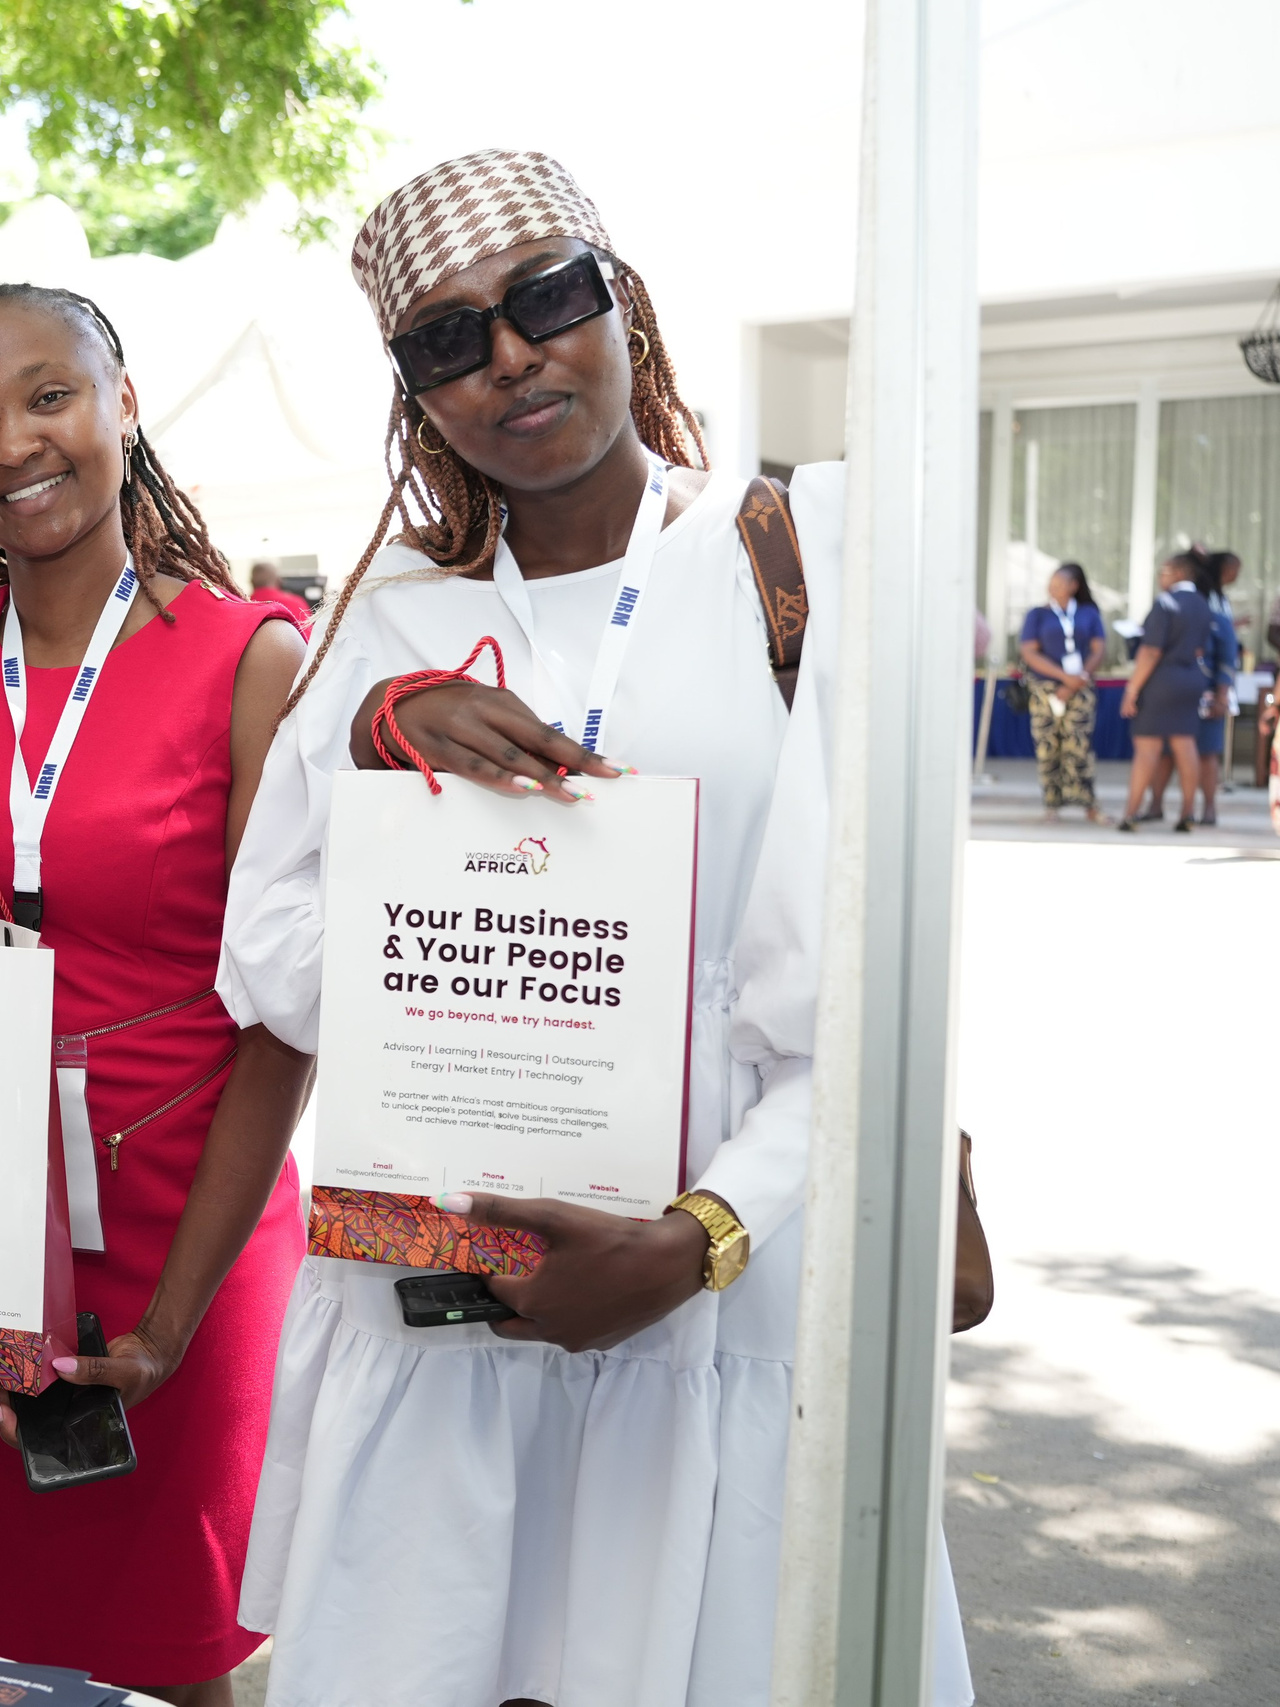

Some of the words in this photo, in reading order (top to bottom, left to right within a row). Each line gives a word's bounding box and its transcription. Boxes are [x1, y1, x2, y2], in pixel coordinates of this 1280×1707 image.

[114, 567, 136, 602] IHRM
[610, 586, 640, 627] IHRM
[3, 657, 20, 688] IHRM
[72, 666, 97, 701] IHRM
[580, 709, 603, 753] IHRM
[34, 763, 57, 799] IHRM
[463, 859, 529, 875] AFRICA
[464, 851, 528, 863] WORKFORCE
[383, 902, 463, 931] Your
[473, 907, 629, 941] Business
[382, 933, 404, 960] &
[415, 936, 496, 965] Your
[507, 941, 625, 980] People
[382, 971, 439, 994] are
[450, 975, 509, 999] our
[519, 975, 621, 1007] Focus
[404, 1005, 425, 1017] We
[427, 1009, 444, 1021] go
[447, 1008, 497, 1024] beyond,
[500, 1015, 519, 1024] we
[521, 1014, 540, 1029] try
[542, 1015, 596, 1030] hardest.
[382, 1041, 426, 1056] Advisory
[433, 1045, 478, 1060] Learning
[485, 1049, 543, 1066] Resourcing
[551, 1054, 615, 1072] Outsourcing
[410, 1059, 445, 1073] Energy
[453, 1063, 489, 1075] Market
[489, 1065, 516, 1080] Entry
[524, 1069, 584, 1086] Technology
[380, 1101, 390, 1109] to
[391, 1101, 420, 1112] unlock
[420, 1104, 456, 1115] people's
[456, 1107, 496, 1119] potential,
[497, 1112, 520, 1121] solve
[520, 1112, 559, 1125] business
[559, 1116, 609, 1131] challenges,
[382, 1090, 397, 1098] We
[397, 1092, 430, 1101] partner
[430, 1094, 449, 1102] with
[450, 1094, 481, 1105] Africa's
[481, 1099, 505, 1108] most
[504, 1100, 548, 1112] ambitious
[549, 1105, 609, 1118] organisations
[404, 1115, 423, 1123] and
[423, 1117, 458, 1126] achieve
[459, 1119, 525, 1135] market-leading
[526, 1125, 583, 1139] performance
[335, 1167, 430, 1182] hello@workforceafrica.com
[371, 1162, 393, 1170] Email
[481, 1172, 505, 1181] Phone
[557, 1189, 651, 1206] www.workforceafrica.com
[588, 1184, 620, 1193] Website
